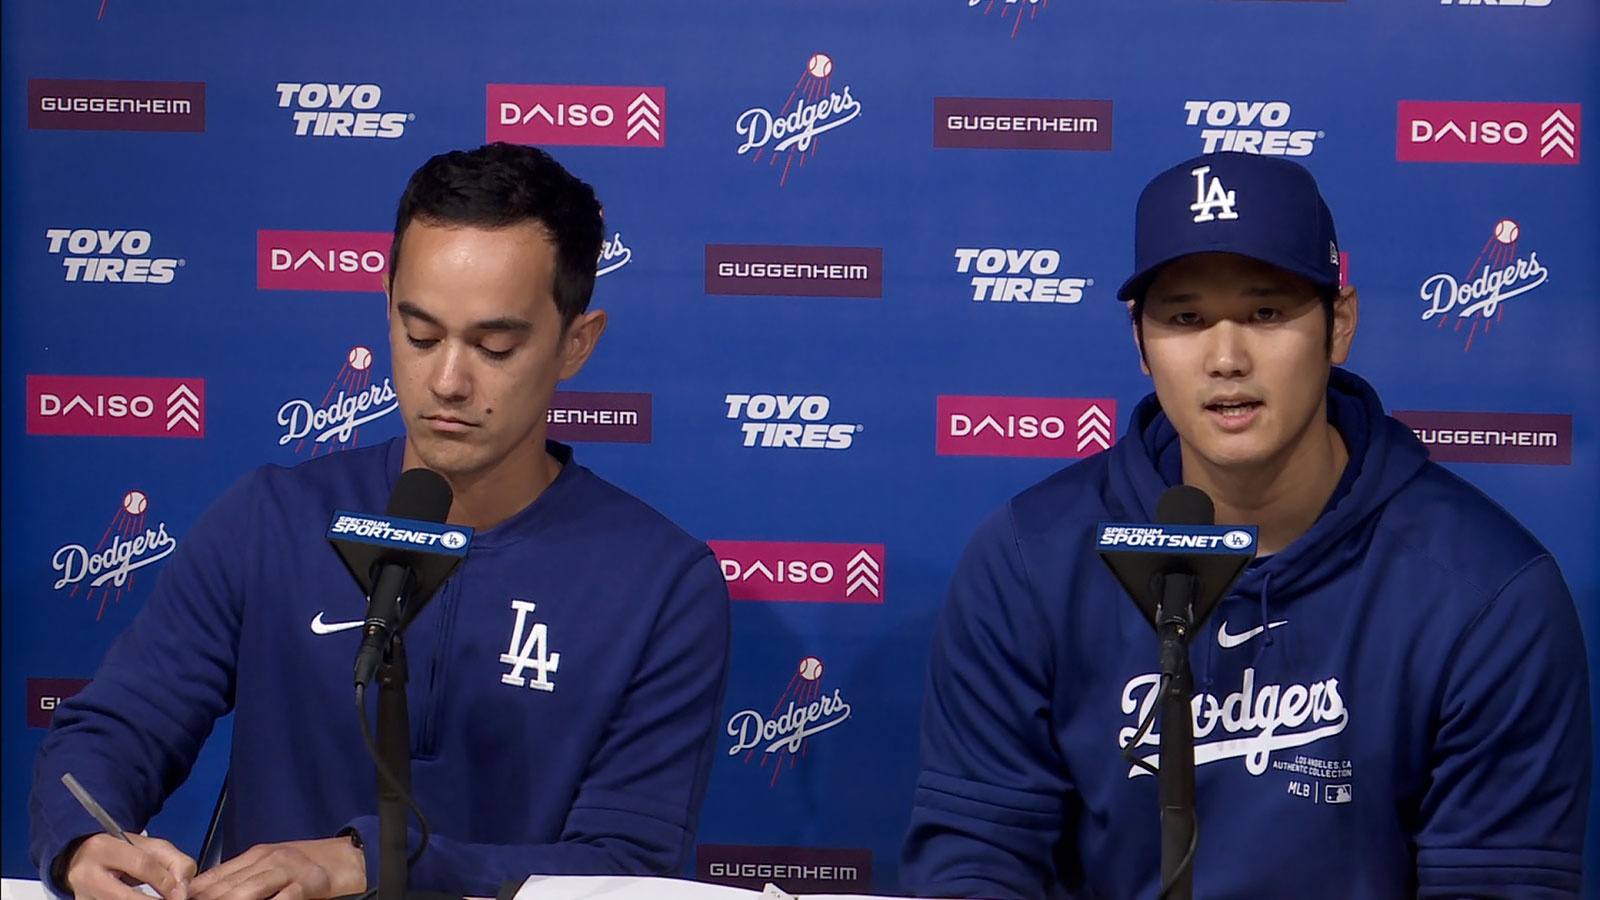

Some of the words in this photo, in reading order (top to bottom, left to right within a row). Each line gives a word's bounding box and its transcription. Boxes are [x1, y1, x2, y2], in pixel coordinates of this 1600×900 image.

[42, 97, 191, 114] GUGGENHEIM
[277, 84, 380, 110] TOYO
[293, 112, 408, 138] TIRES
[501, 103, 614, 127] DAISO
[737, 85, 861, 155] Dodgers
[948, 116, 1098, 132] GUGGENHEIM
[1184, 101, 1291, 128] TOYO
[1201, 130, 1316, 156] TIRES
[1412, 121, 1528, 144] DAISO
[1191, 166, 1239, 222] LA
[47, 229, 152, 255] TOYO
[63, 258, 178, 284] TIRES
[272, 249, 385, 273] DAISO
[719, 263, 868, 279] GUGGENHEIM
[955, 248, 1060, 275] TOYO
[971, 277, 1086, 303] TIRES
[1421, 252, 1548, 320] Dodgers
[40, 394, 154, 418] DAISO
[278, 378, 399, 445] Dodgers
[725, 394, 830, 421] TOYO
[742, 423, 856, 449] TIRES
[951, 415, 1065, 439] DAISO
[332, 522, 442, 546] SPORTSNET
[338, 516, 391, 528] SPECTRUM
[1104, 526, 1163, 536] SPECTRUM
[1100, 533, 1223, 548] SPORTSNET
[53, 523, 177, 590] Dodgers
[720, 559, 834, 583] DAISO
[499, 600, 560, 692] LA
[727, 688, 851, 756] Dodgers
[1272, 760, 1308, 773] AUTHENTC
[1341, 760, 1352, 768] CA
[1287, 780, 1310, 797] MLB
[710, 863, 858, 880] GUGGENHEIM
